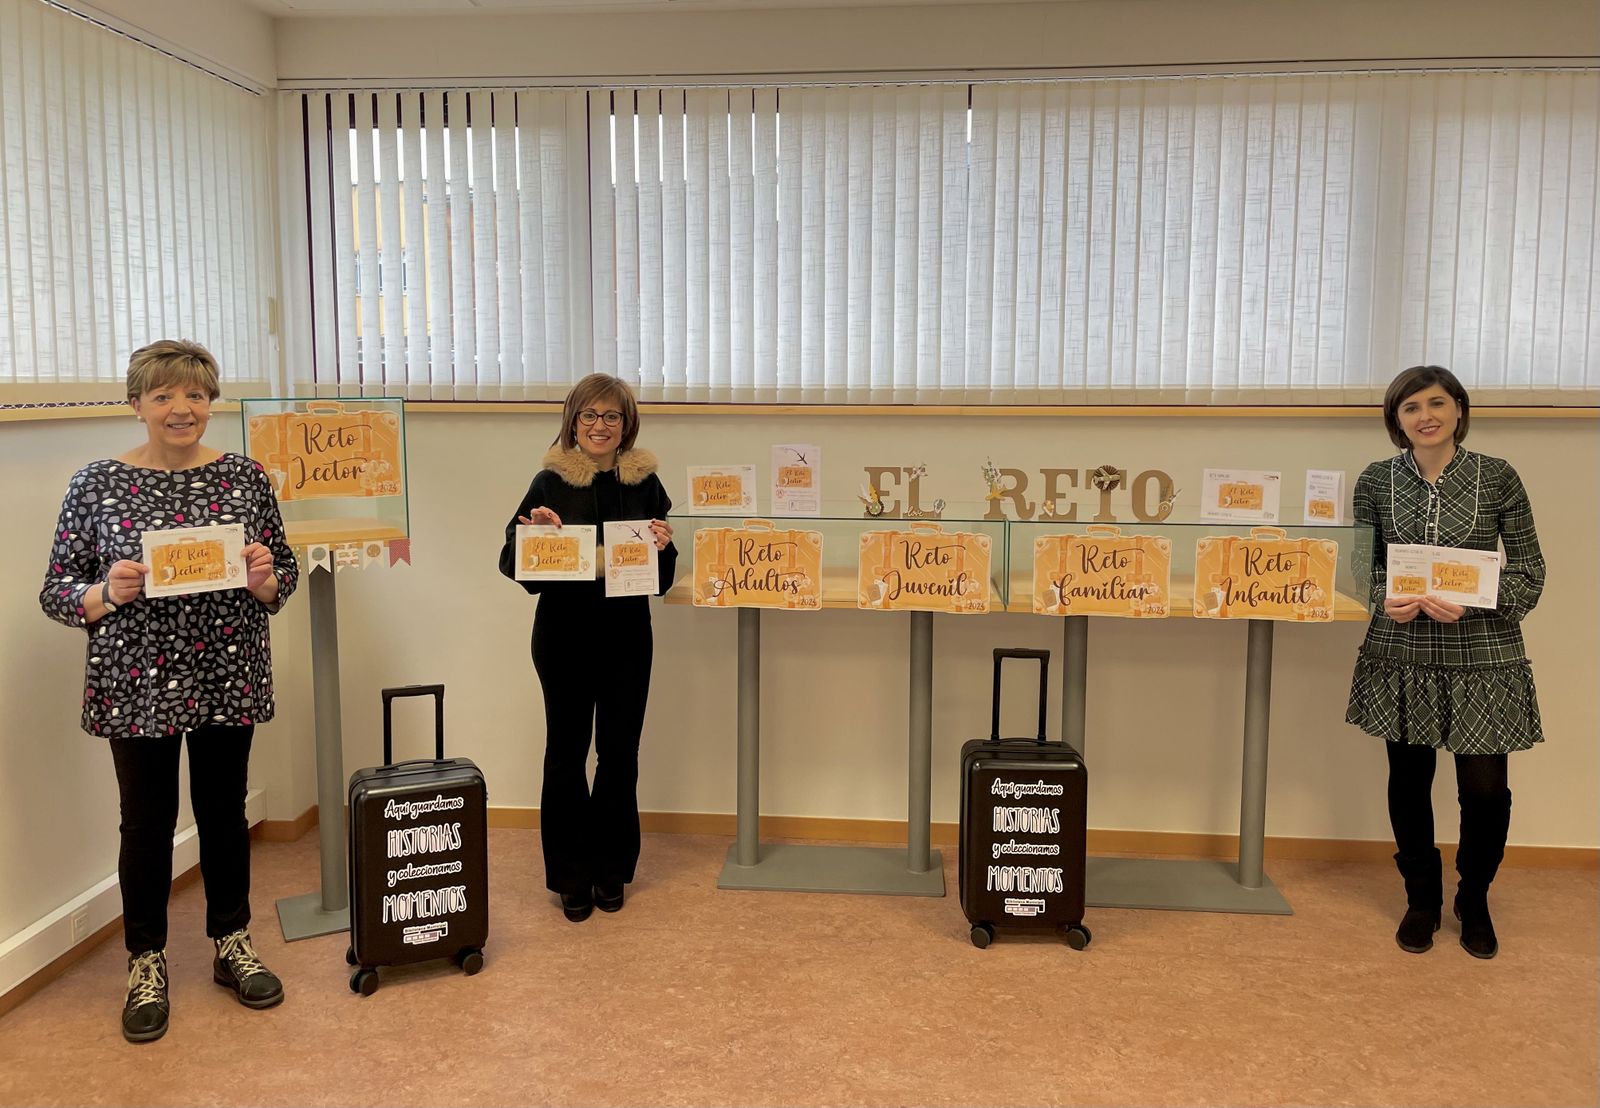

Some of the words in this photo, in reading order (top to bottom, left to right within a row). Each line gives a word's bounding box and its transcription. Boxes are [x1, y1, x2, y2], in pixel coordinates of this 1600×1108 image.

[297, 423, 372, 455] Reto
[292, 456, 368, 490] Lector
[864, 466, 941, 519] EL
[983, 468, 1174, 522] RETO
[188, 548, 209, 561] Reto
[733, 537, 798, 567] Reto
[899, 540, 966, 570] Reto
[1075, 543, 1145, 574] Reto
[1240, 546, 1310, 577] Reto
[171, 563, 207, 580] Lector
[712, 567, 806, 598] Adultos
[881, 570, 968, 601] Juvenil
[1220, 577, 1318, 607] Infantil
[1014, 780, 1063, 799] guardamos
[410, 795, 464, 819] guardamos
[993, 806, 1060, 834] HISTORIAS
[387, 823, 461, 858] HISTORIAS
[992, 843, 1000, 859] y
[1001, 839, 1060, 855] coleccionamos
[387, 871, 396, 887] y
[397, 861, 462, 880] coleccionamos
[987, 865, 1063, 893] MOMENTOS
[383, 885, 467, 923] MOMENTOS
